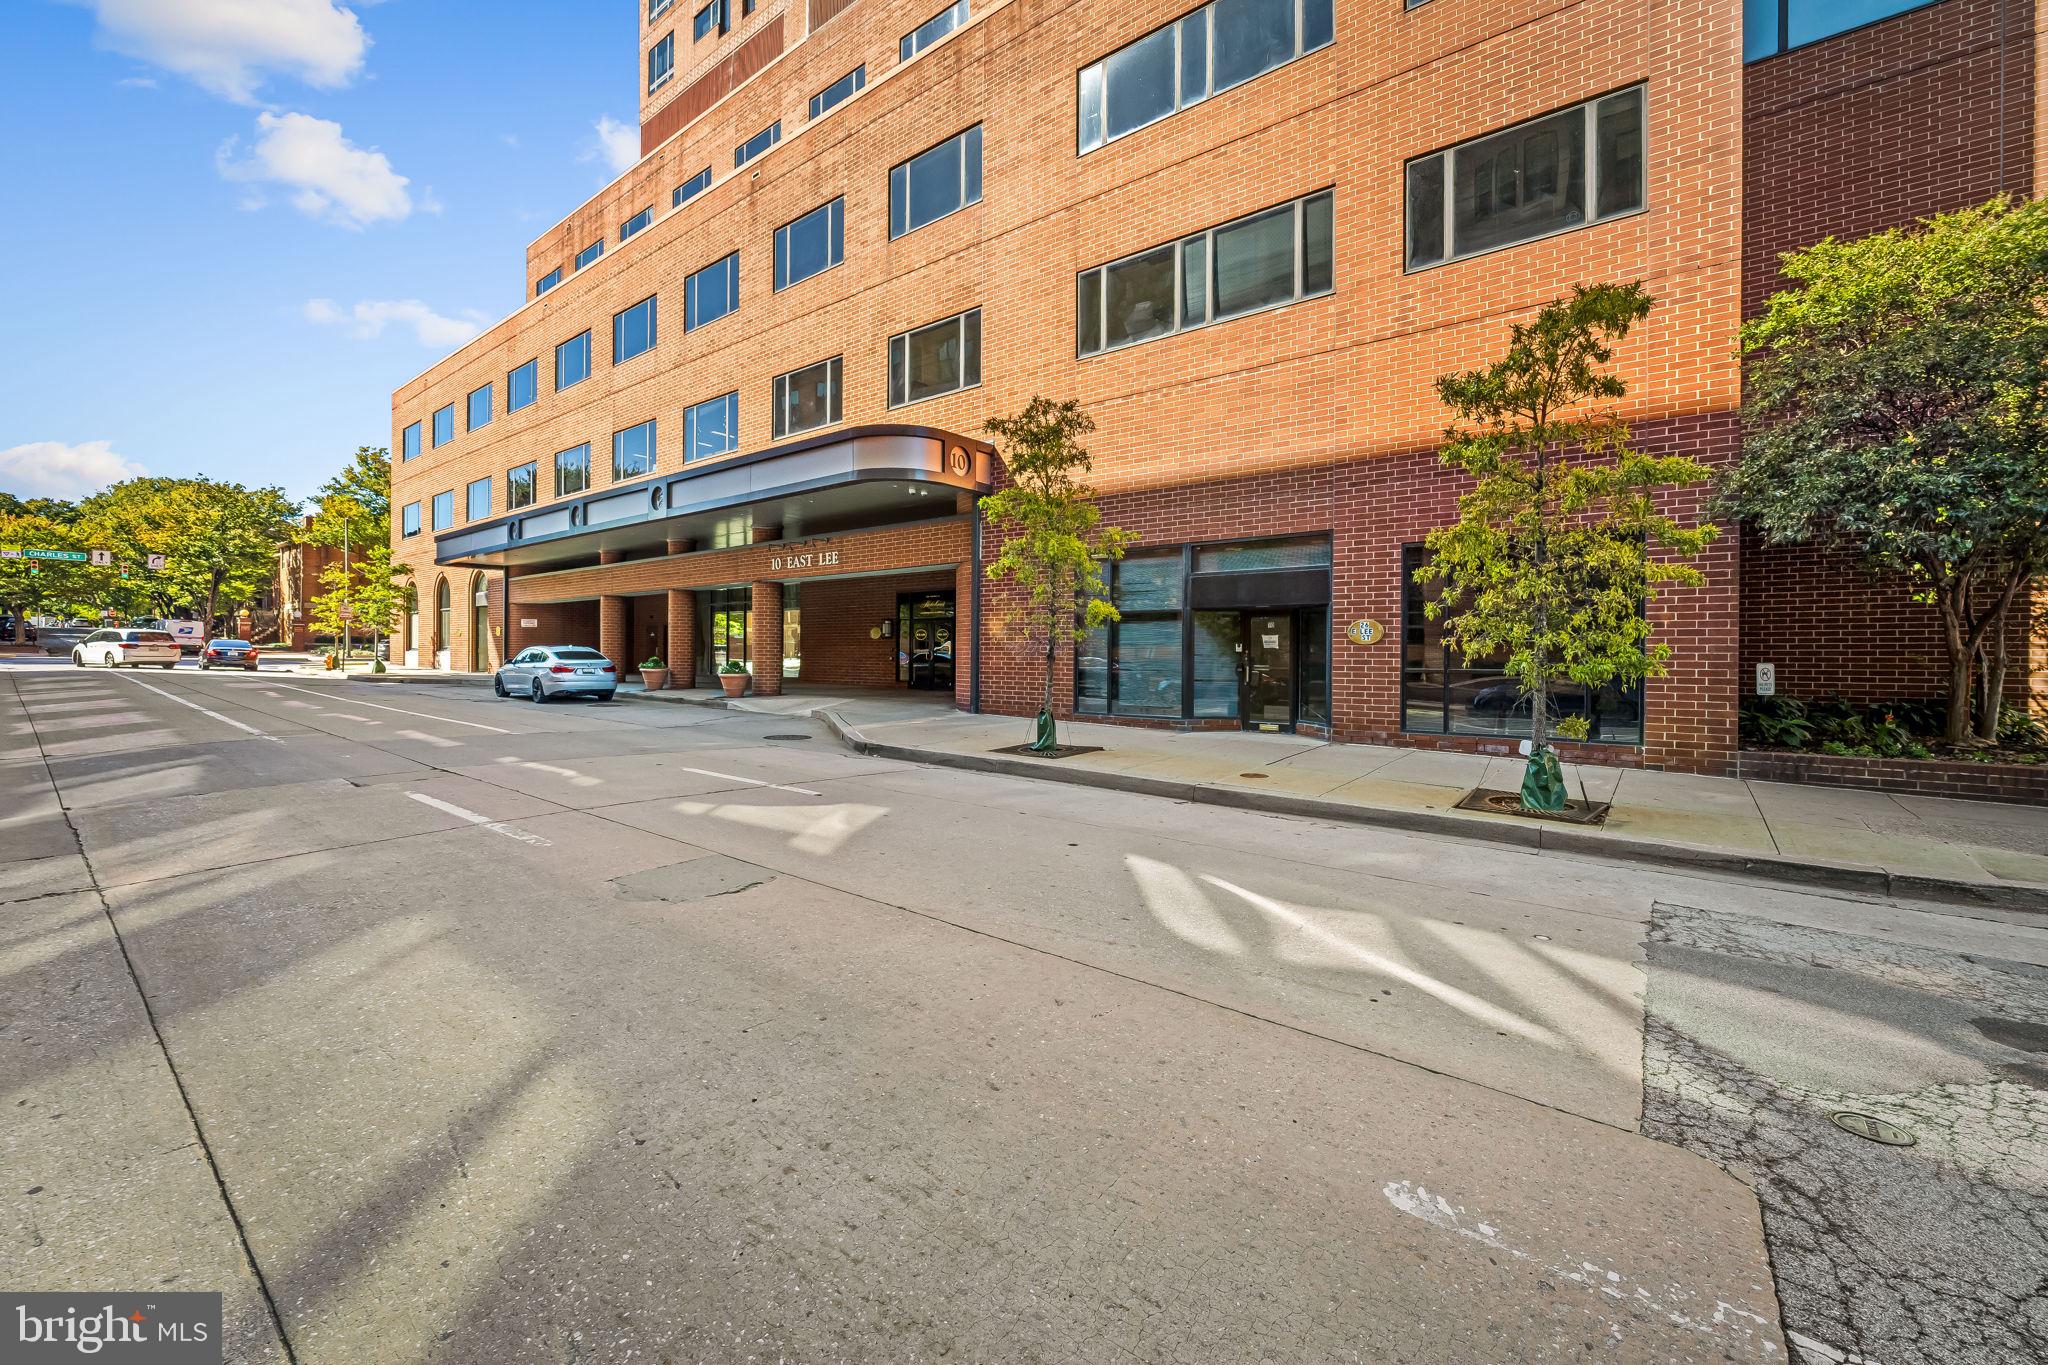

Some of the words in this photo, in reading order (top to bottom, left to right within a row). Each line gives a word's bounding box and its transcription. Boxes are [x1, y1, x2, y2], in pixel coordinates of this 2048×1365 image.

[951, 453, 965, 470] 10
[29, 550, 69, 559] CHARLES
[771, 557, 781, 570] 10
[787, 554, 813, 568] EAST
[818, 551, 838, 565] LEE
